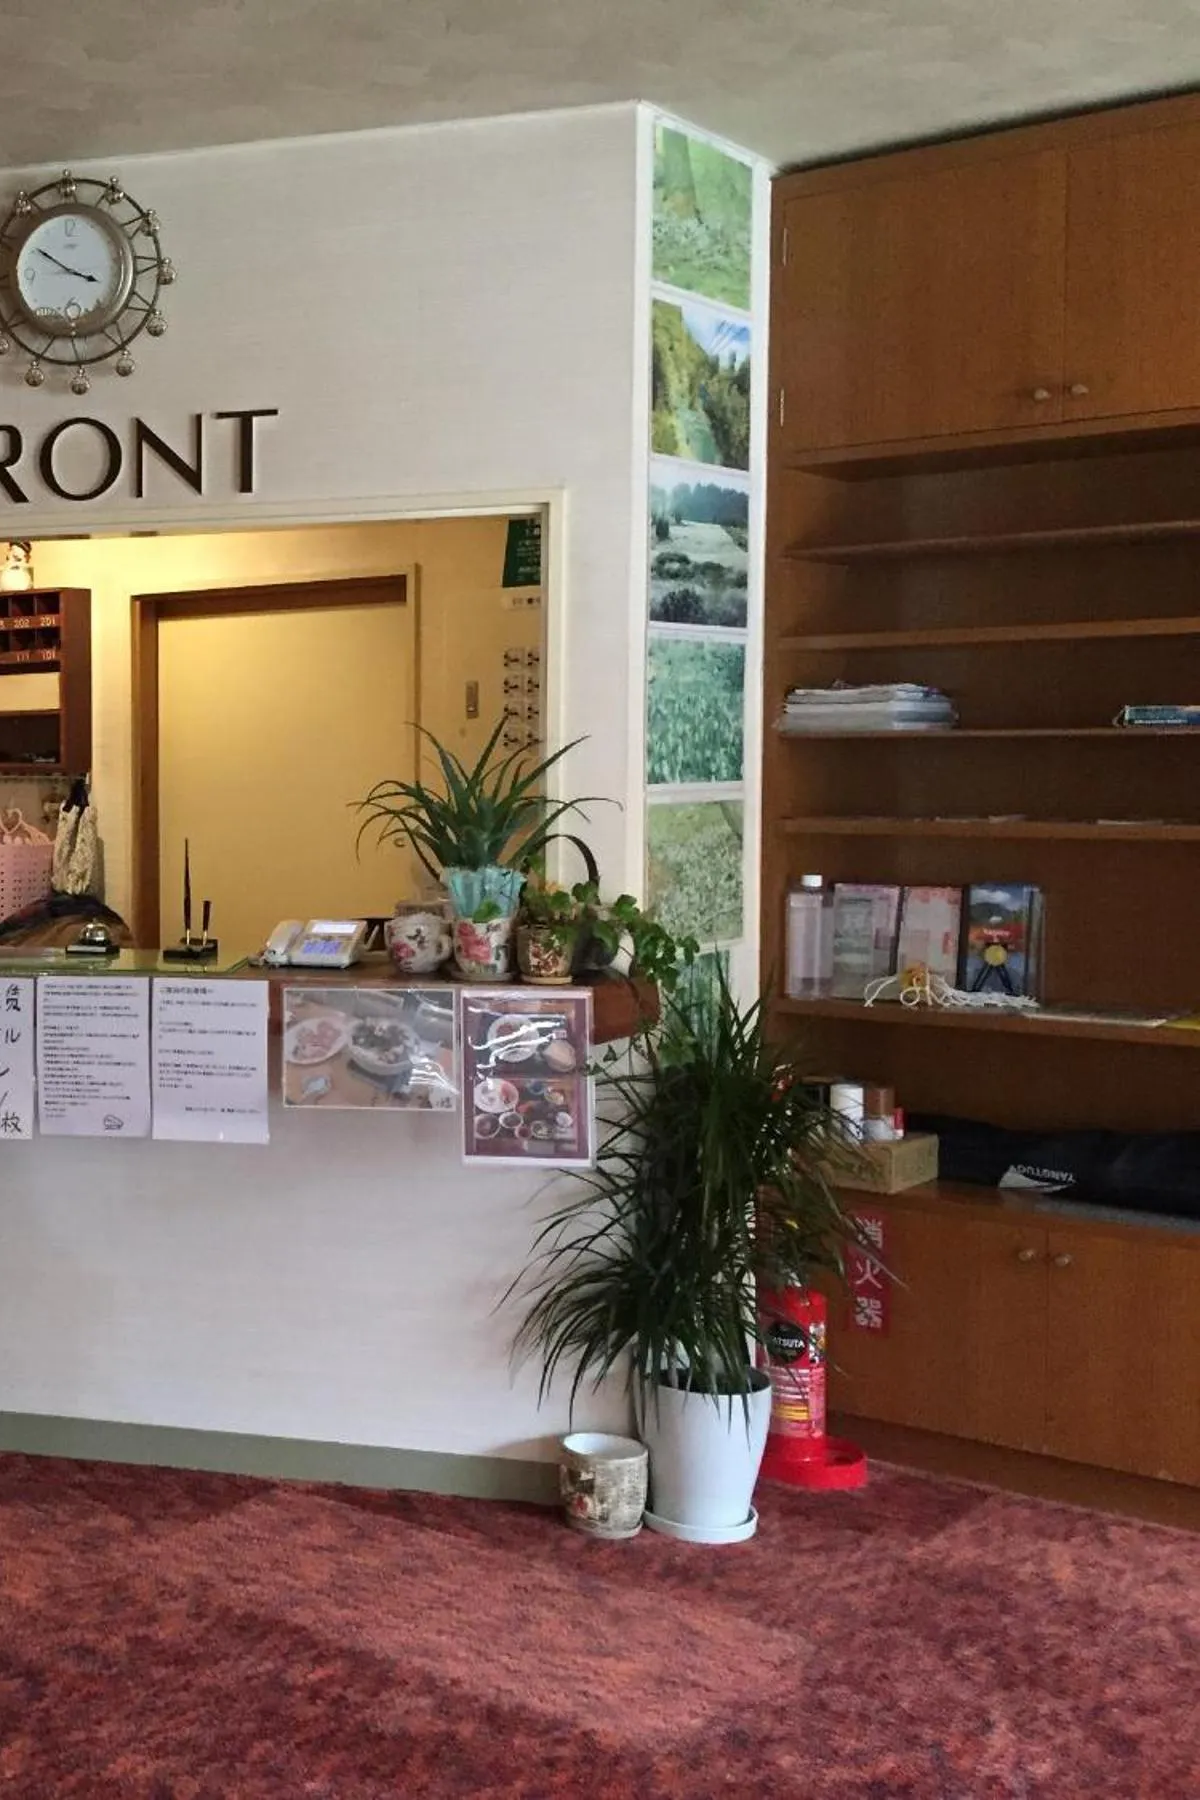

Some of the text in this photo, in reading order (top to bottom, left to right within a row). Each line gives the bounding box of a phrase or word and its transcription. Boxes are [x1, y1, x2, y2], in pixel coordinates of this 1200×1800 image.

[40, 616, 56, 627] 201
[855, 1216, 883, 1329] 消火器
